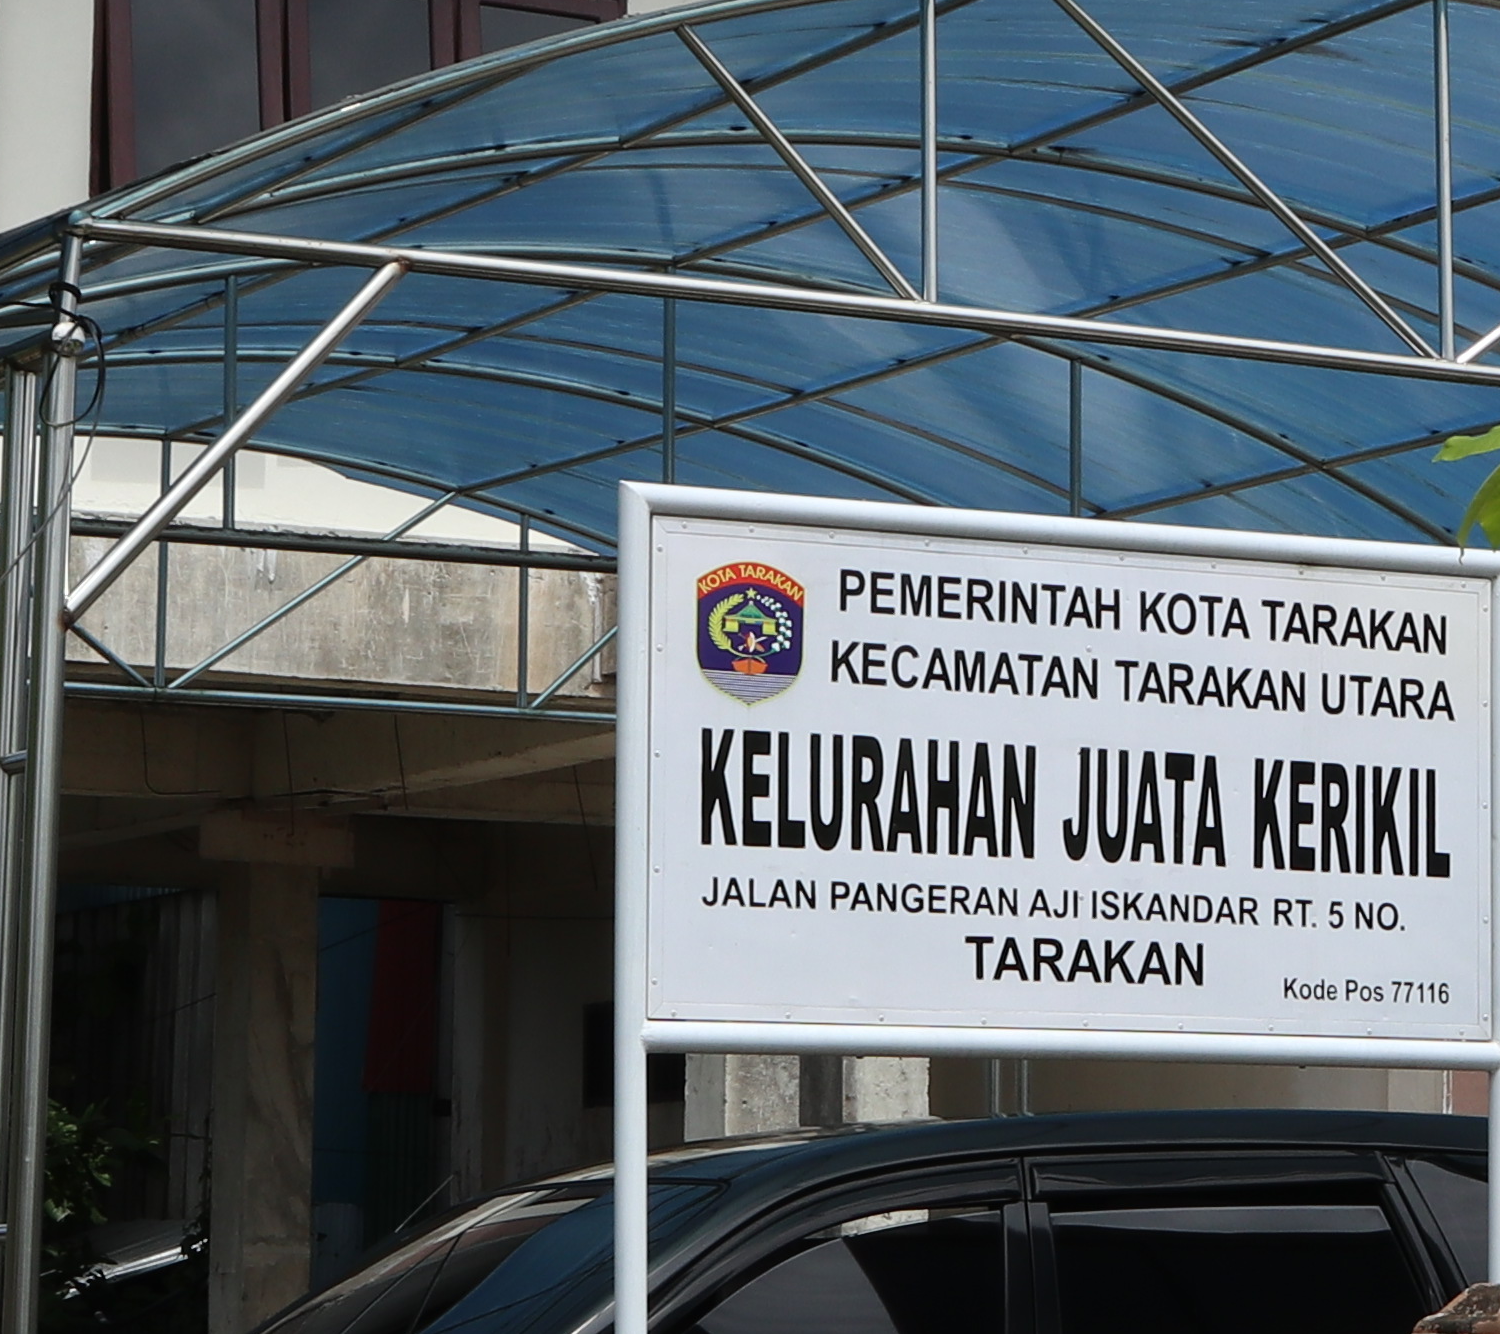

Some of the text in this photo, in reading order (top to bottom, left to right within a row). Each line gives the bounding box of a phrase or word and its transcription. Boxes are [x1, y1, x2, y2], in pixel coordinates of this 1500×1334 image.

[698, 564, 803, 601] KOTA TARAKAN
[839, 568, 1447, 655] PEMERINTAH KOTA TARAKAN
[831, 640, 1455, 722] KECAMATAN TARAKAN UTARA
[701, 727, 1451, 879] KELURAHAN JUATA KERIKIL
[702, 876, 1407, 931] JALAN PANGERAN AJI ISKANDAR RT. 5 NO.
[964, 935, 1204, 987] TARAKAN
[1284, 977, 1450, 1005] Kode Pos 77116
